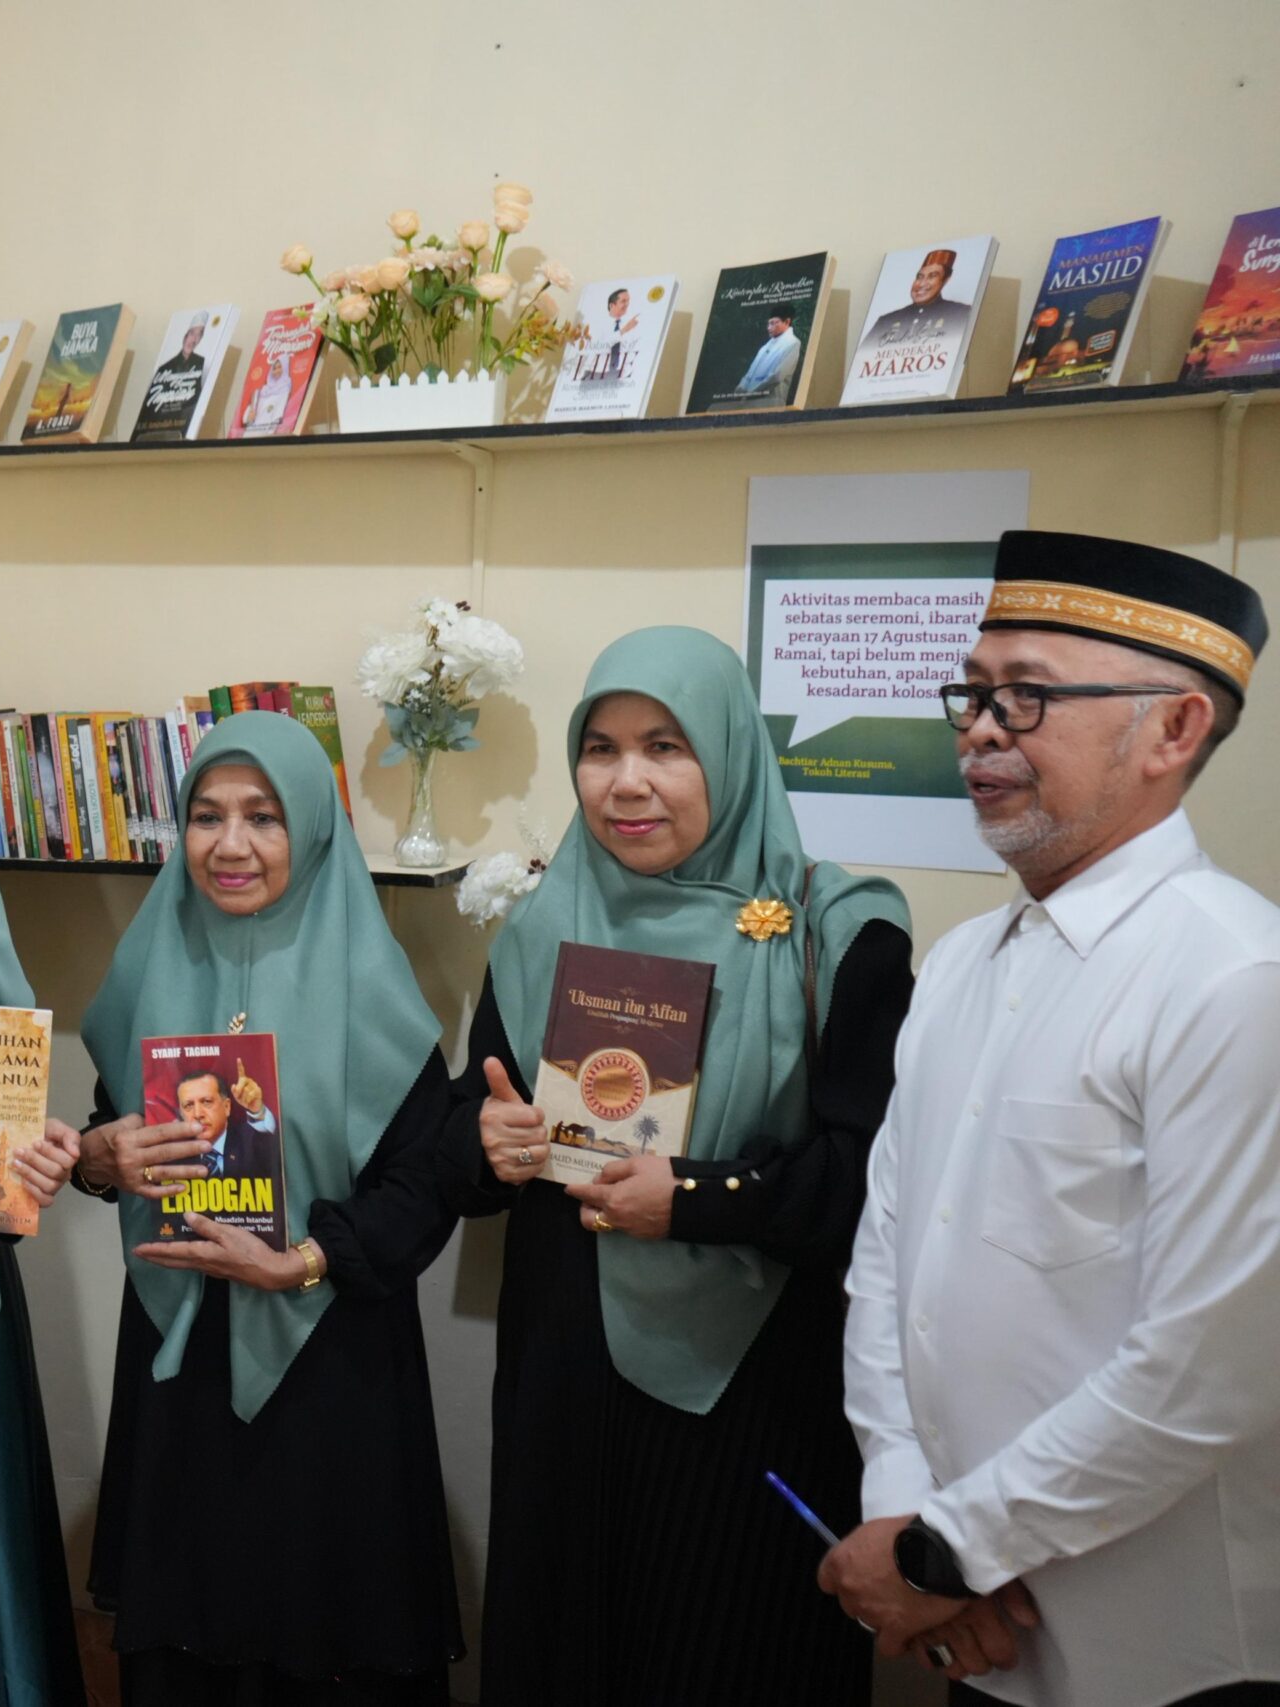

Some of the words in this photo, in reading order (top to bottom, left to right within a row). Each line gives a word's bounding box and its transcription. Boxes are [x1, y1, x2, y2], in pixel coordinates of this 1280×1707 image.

[1058, 244, 1144, 269] MANAJEMEN
[1048, 255, 1142, 290] MASJID
[71, 321, 98, 340] BUYA
[60, 337, 98, 357] HAMKA
[875, 343, 941, 359] MENDEKAP
[859, 351, 948, 378] MAROS
[780, 592, 850, 606] Aktivitas
[854, 592, 931, 606] membaca
[935, 592, 985, 606] masih
[785, 610, 842, 624] sebatas
[846, 611, 924, 626] seremoni,
[929, 611, 978, 624] ibarat
[788, 632, 860, 646] perayaan
[864, 633, 878, 645] 17
[881, 630, 972, 647] Agustusan.
[774, 647, 826, 662] Ramai,
[831, 647, 860, 664] tapi
[865, 647, 915, 661] belum
[920, 648, 969, 666] menja
[801, 665, 891, 682] kebutuhan,
[896, 667, 955, 684] apalagi
[807, 682, 887, 698] kesadaran
[891, 684, 941, 698] kolosa
[779, 756, 817, 766] Bachtiar
[820, 758, 851, 767] Adnan
[854, 759, 896, 770] Kusuma,
[803, 767, 832, 776] Tokoh
[835, 768, 870, 778] Literasi
[88, 779, 98, 810] FILOSOFI
[92, 812, 100, 834] TERAS
[624, 998, 645, 1016] ibn
[152, 1048, 181, 1059] SYARIF
[183, 1046, 220, 1057] TAGHIAN
[161, 1178, 274, 1213] ERDOGAN
